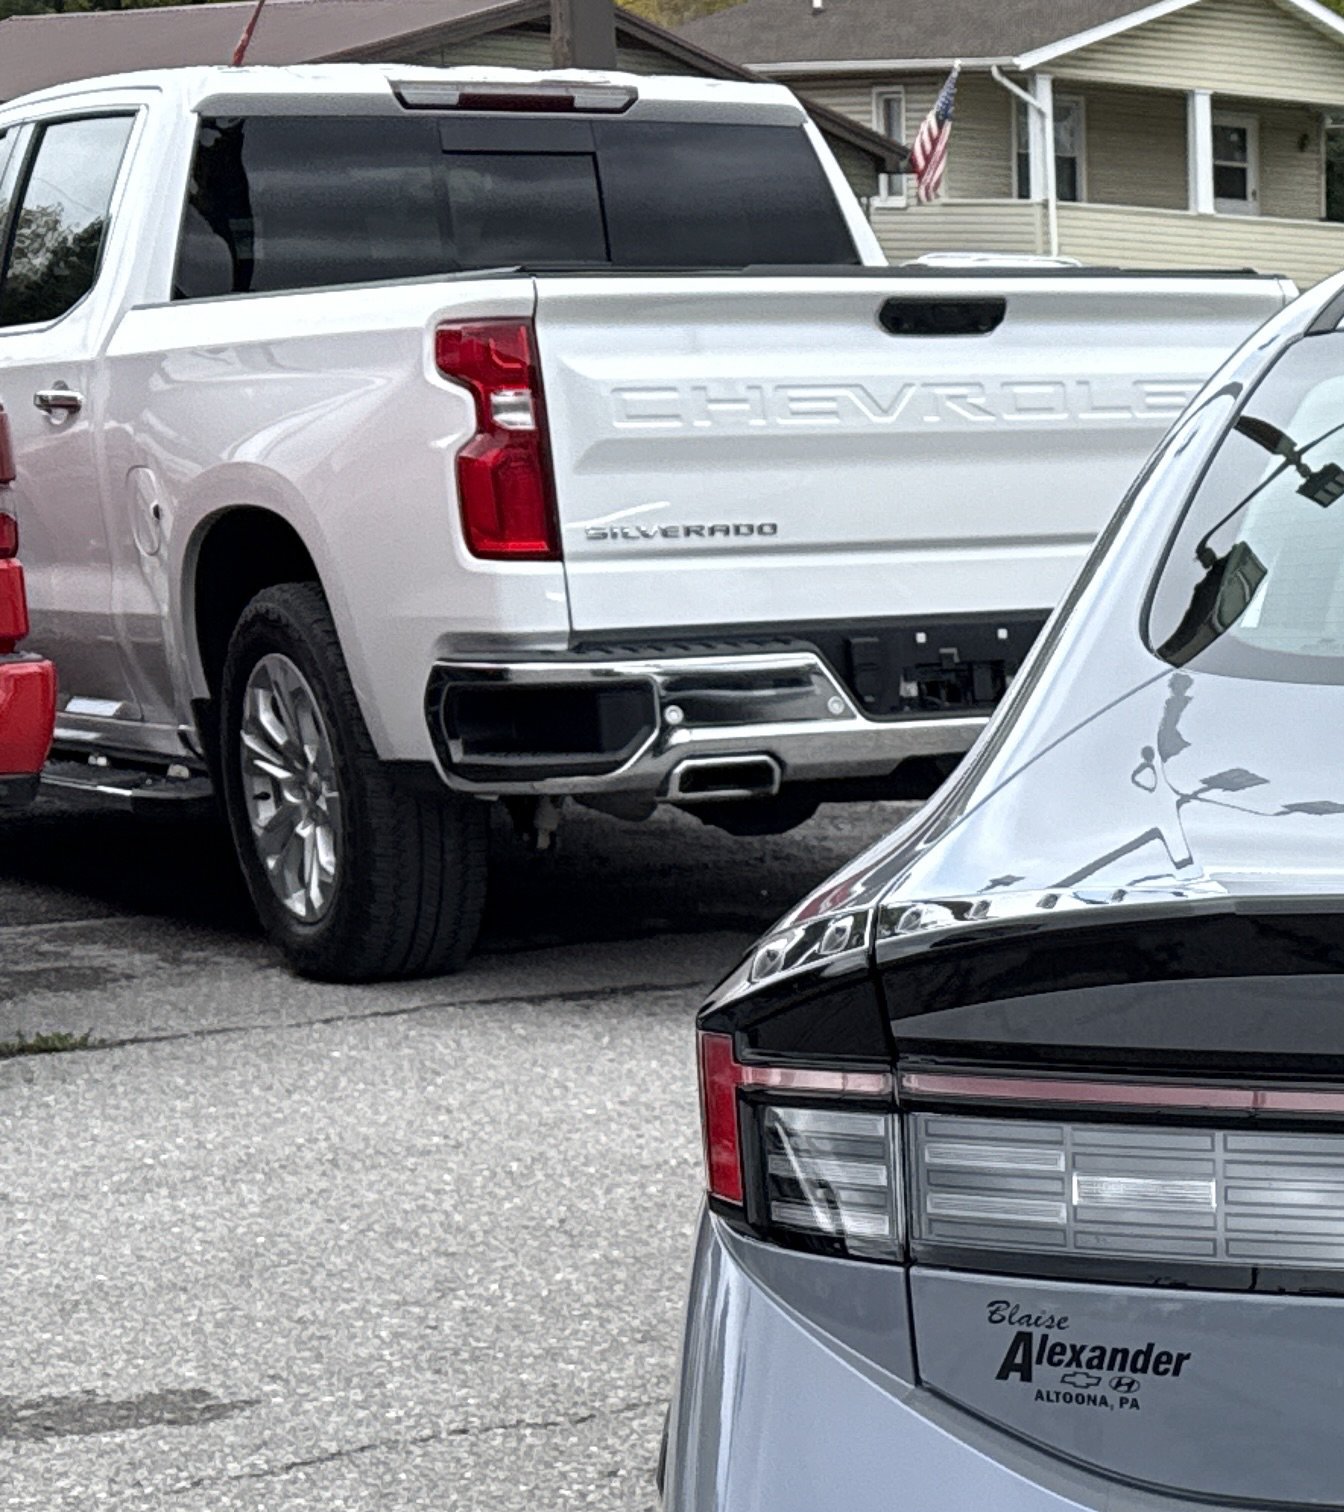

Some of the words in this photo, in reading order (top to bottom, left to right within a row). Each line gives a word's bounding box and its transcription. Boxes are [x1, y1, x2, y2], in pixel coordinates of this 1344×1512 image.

[609, 379, 1204, 428] CHEVROLE
[584, 522, 779, 542] SILVERADO
[986, 1300, 1070, 1331] Blaise
[995, 1330, 1192, 1383] Alexander
[1034, 1389, 1115, 1411] ALTOONA,
[1119, 1396, 1141, 1411] PA
